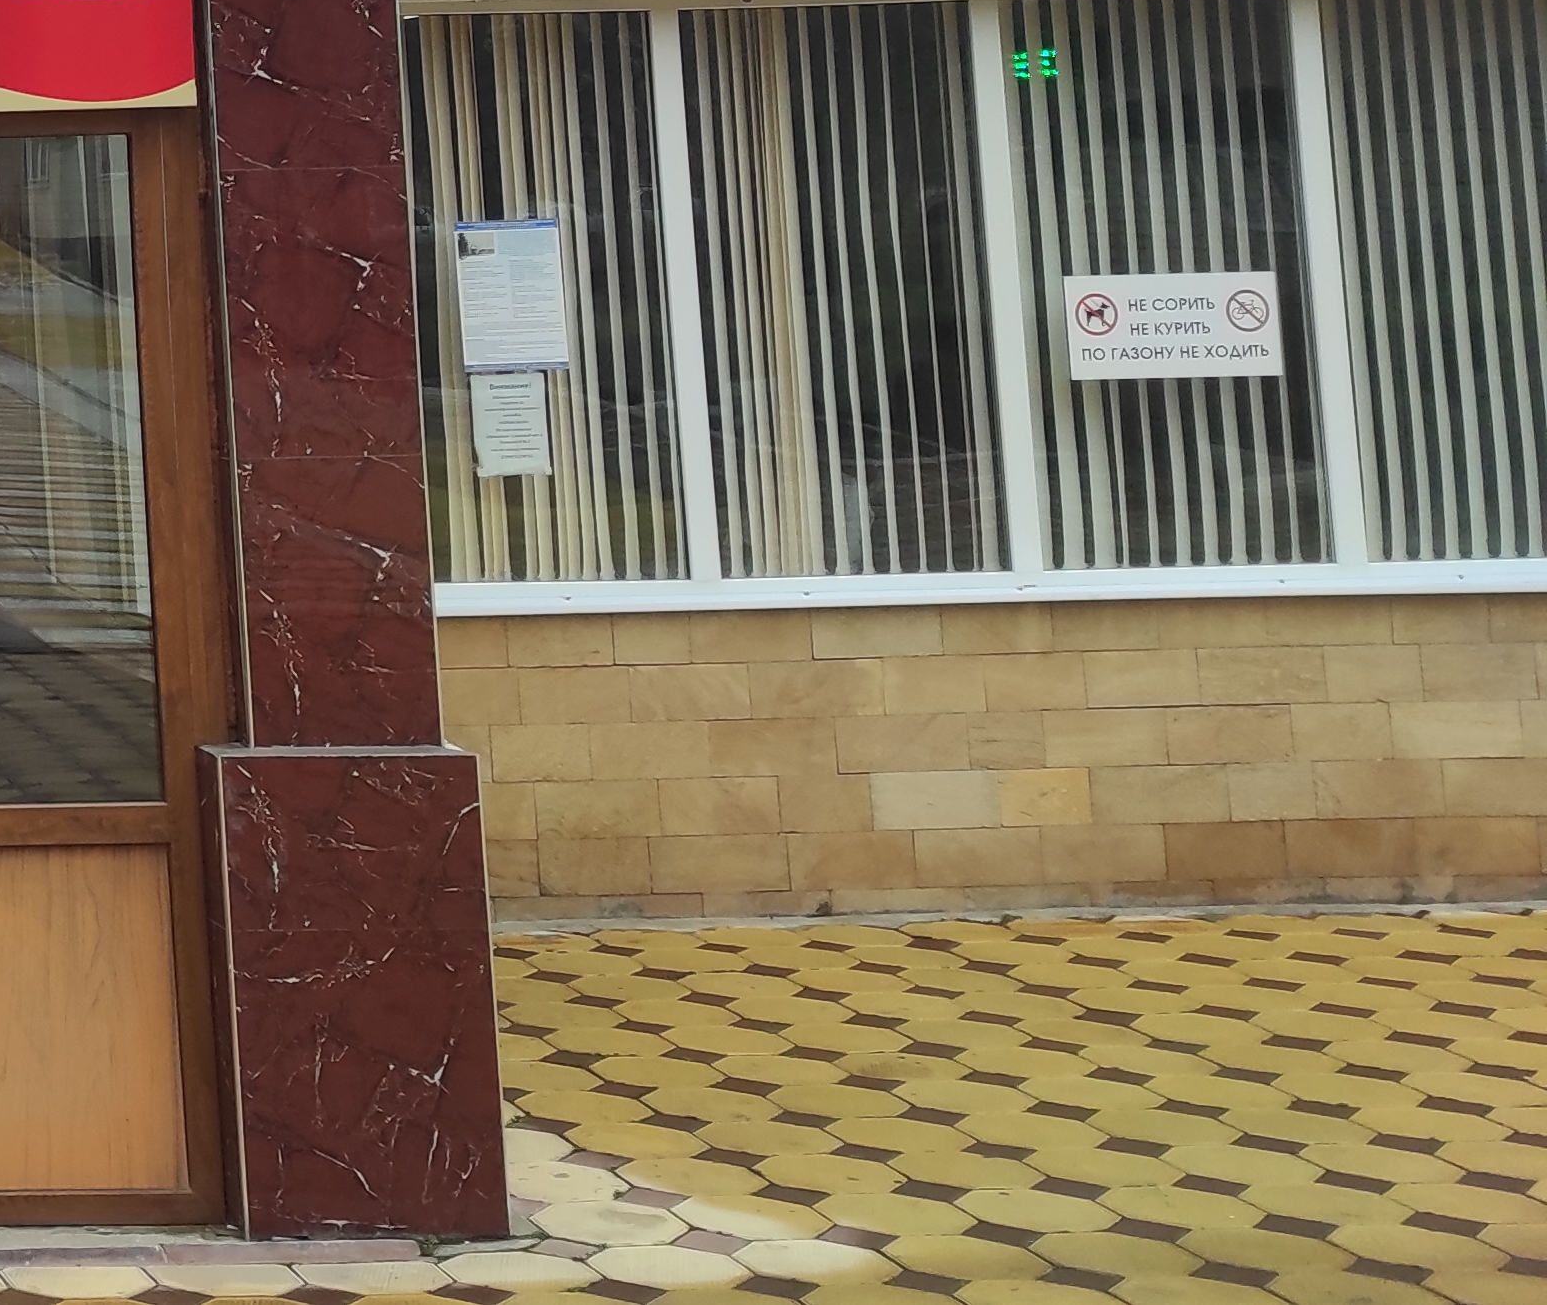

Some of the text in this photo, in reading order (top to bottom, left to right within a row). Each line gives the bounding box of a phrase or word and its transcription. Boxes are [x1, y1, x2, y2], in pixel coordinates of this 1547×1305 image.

[1128, 297, 1216, 312] НЕ СОРИТЬ
[1130, 322, 1211, 336] НЕ КУРИТЬ
[1081, 344, 1270, 362] ПО ГАЗОНУ НЕ ХОДИТЬ
